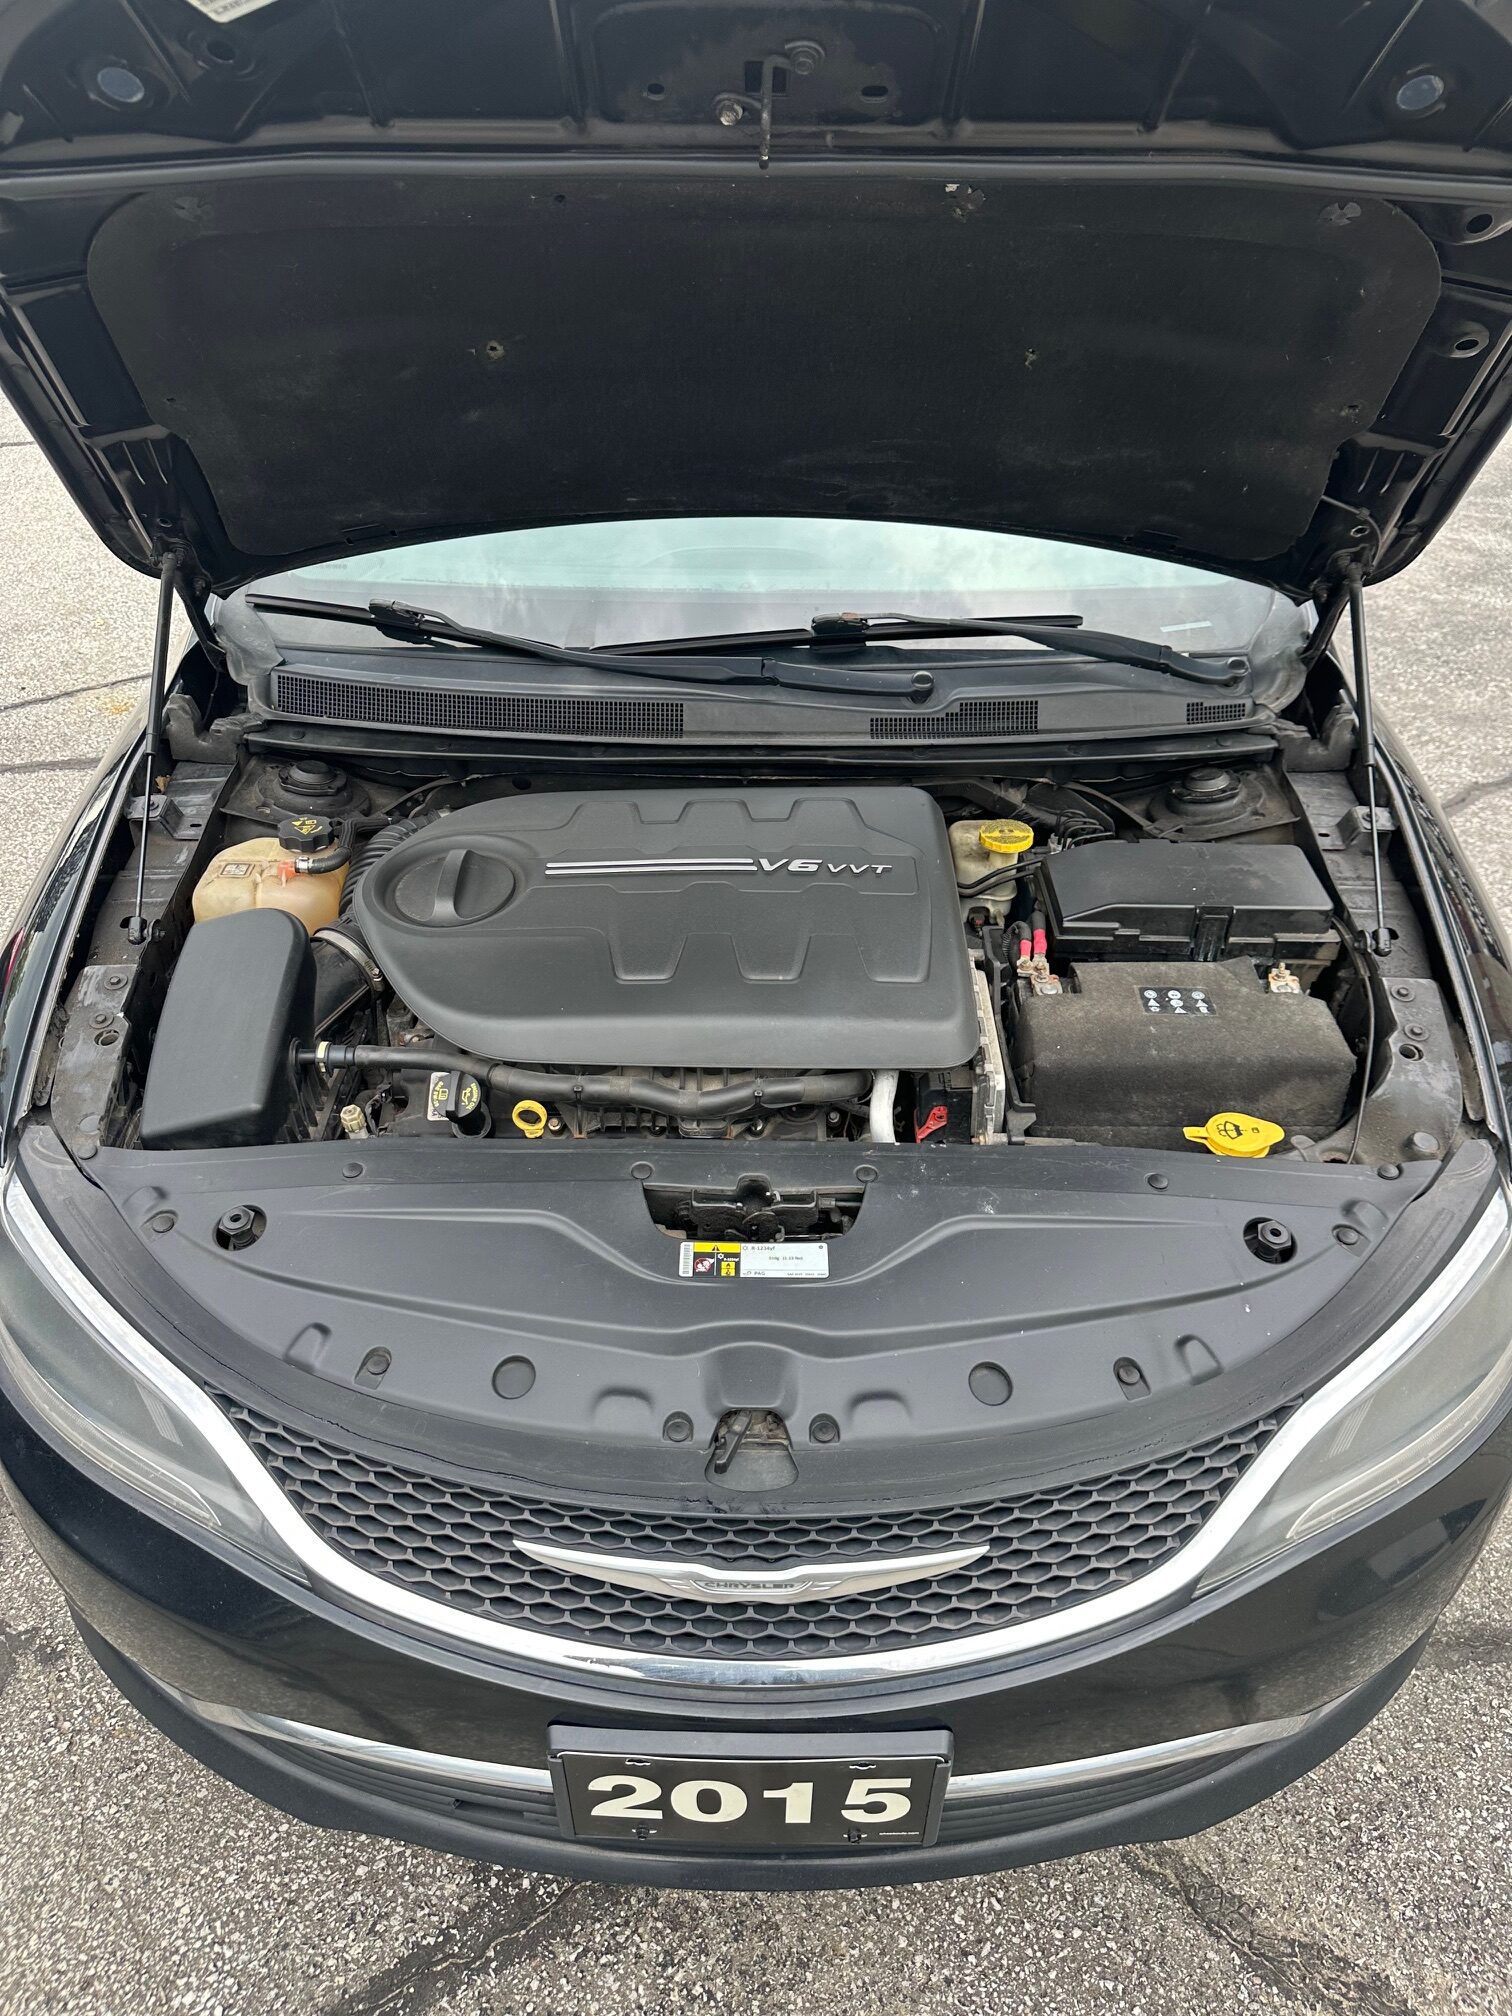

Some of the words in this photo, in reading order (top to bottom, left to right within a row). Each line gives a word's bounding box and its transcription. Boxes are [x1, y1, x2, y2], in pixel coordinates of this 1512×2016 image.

[758, 858, 823, 872] V6
[827, 863, 893, 874] VVT
[465, 1102, 475, 1110] OIL
[704, 1581, 795, 1589] CHRYSLER
[587, 1774, 912, 1824] 2015
